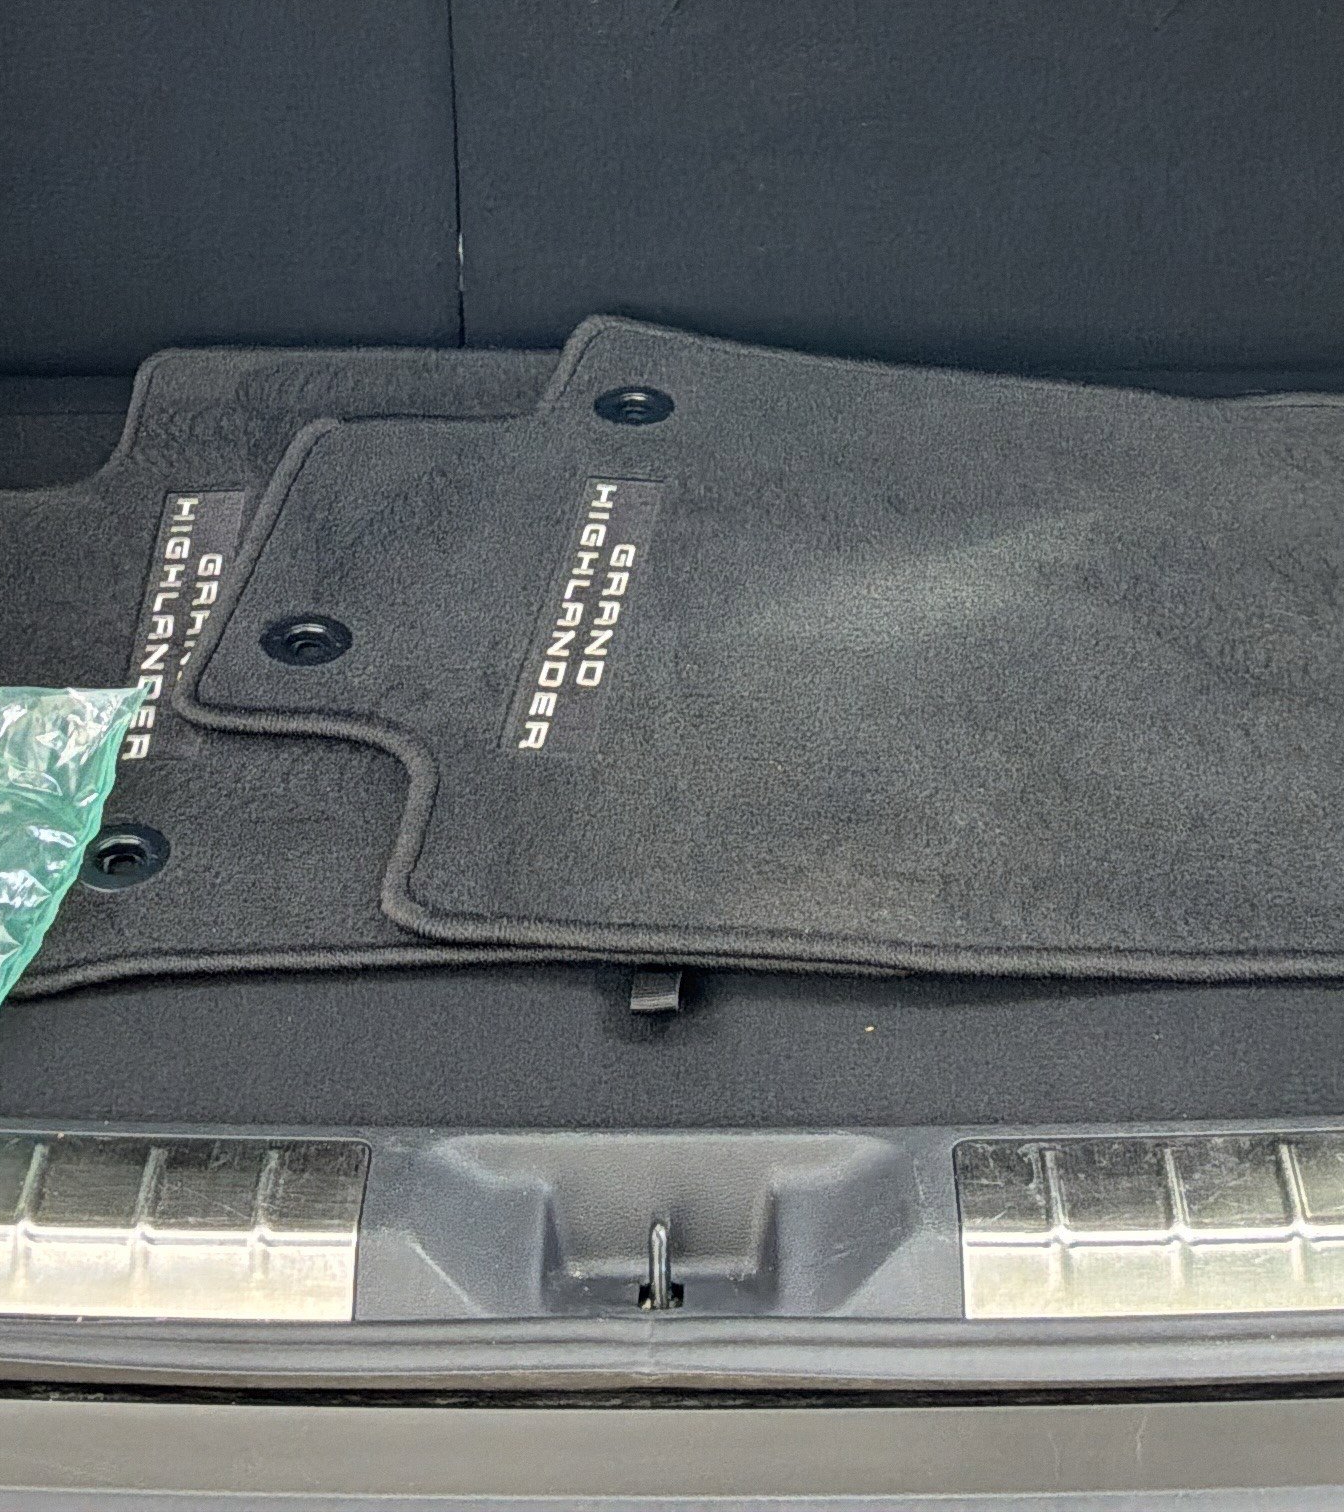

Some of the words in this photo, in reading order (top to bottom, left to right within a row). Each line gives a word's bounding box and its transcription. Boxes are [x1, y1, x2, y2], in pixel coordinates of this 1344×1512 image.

[121, 497, 199, 761] HIGHLANDER
[176, 553, 223, 681] GRA
[518, 483, 617, 749] HIGHLANDER
[575, 543, 636, 687] GRAND
